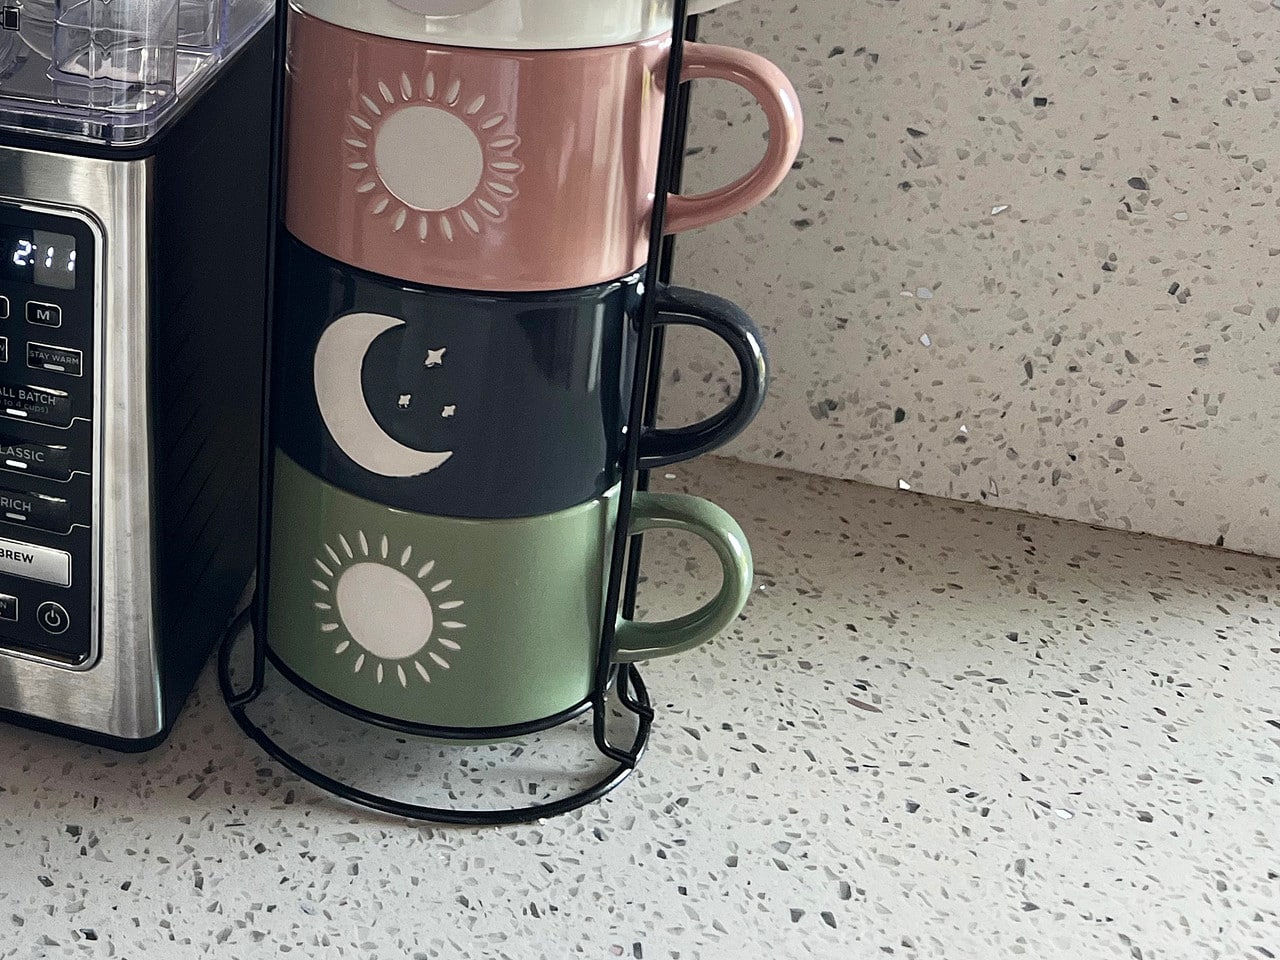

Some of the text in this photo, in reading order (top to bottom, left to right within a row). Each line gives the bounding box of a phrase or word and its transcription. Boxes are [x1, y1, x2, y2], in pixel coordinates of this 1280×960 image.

[13, 240, 76, 271] 2:11
[36, 309, 50, 321] M
[30, 351, 79, 365] STAY WARM
[18, 389, 56, 406] BATCH
[4, 398, 13, 407] to
[23, 403, 49, 414] cups)
[0, 496, 32, 512] RICH
